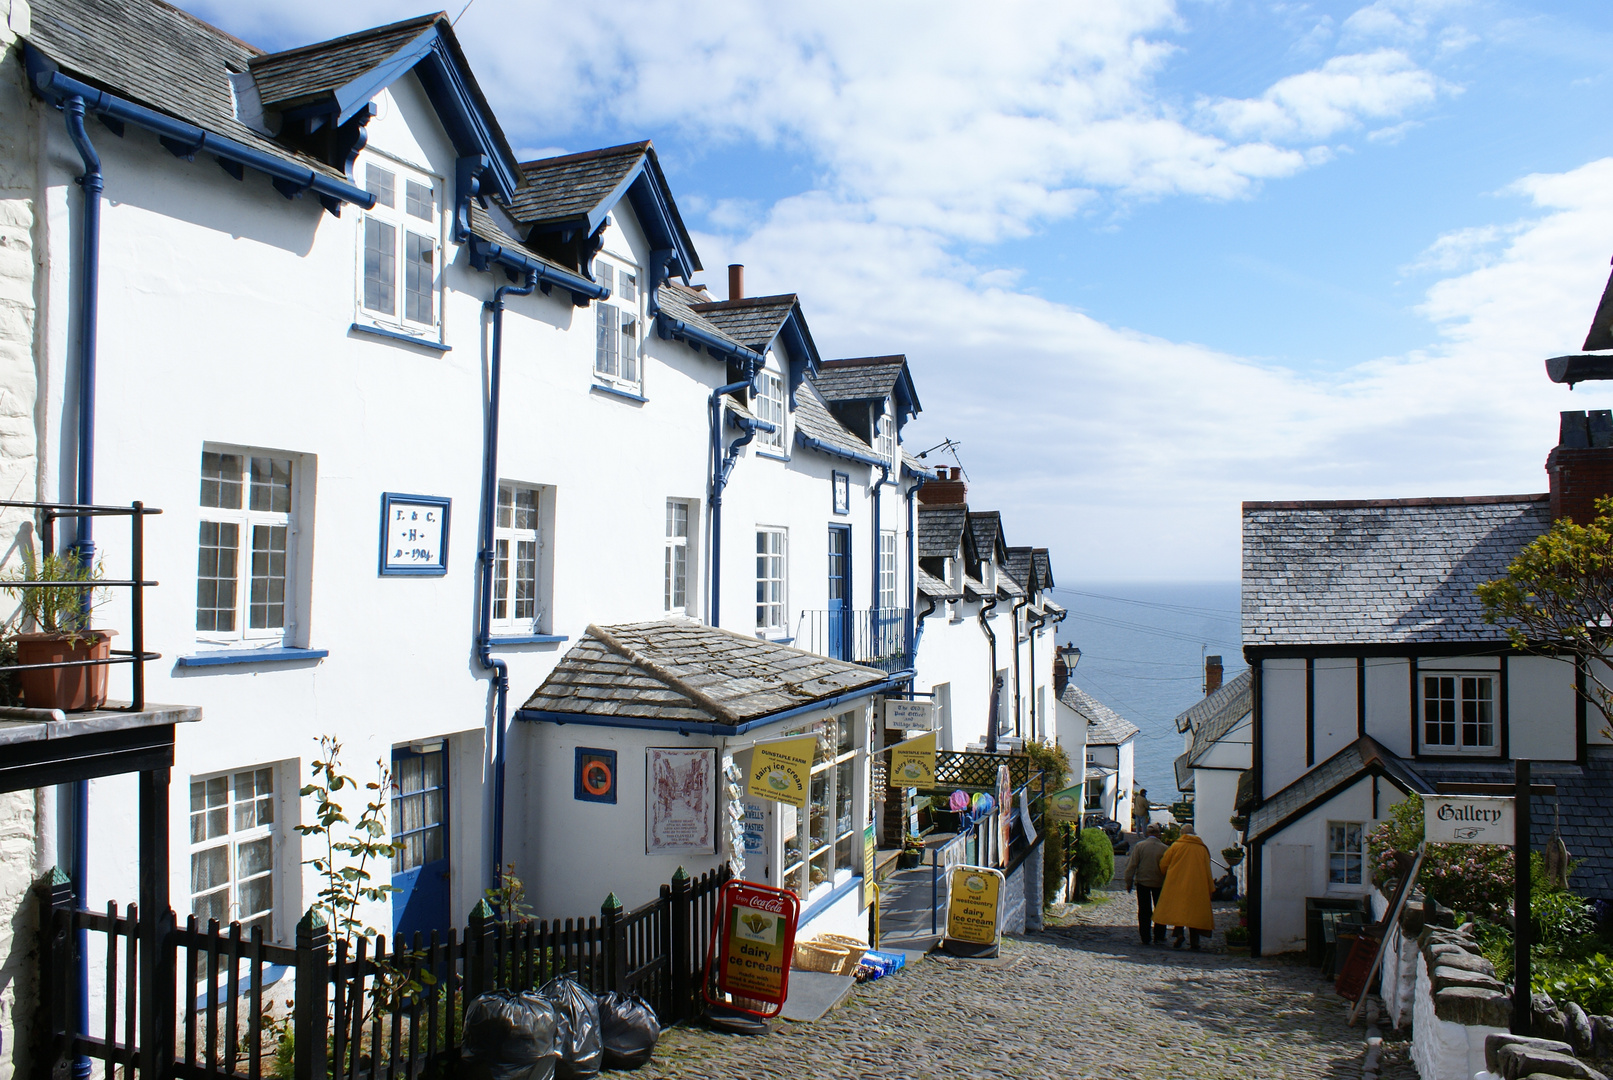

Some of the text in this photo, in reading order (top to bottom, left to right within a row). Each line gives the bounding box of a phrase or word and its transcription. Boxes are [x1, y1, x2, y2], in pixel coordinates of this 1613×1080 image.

[762, 750, 791, 760] DUNSTAPLE
[895, 761, 906, 774] dairy
[917, 760, 931, 776] cream
[755, 762, 802, 790] dairy ice cream
[1437, 803, 1501, 825] Gallery
[745, 823, 764, 831] PASTIES
[736, 895, 748, 903] Enjoy
[956, 898, 993, 907] westcountry
[963, 908, 984, 918] dairy
[967, 917, 994, 926] cream
[740, 944, 771, 961] dairy
[729, 954, 743, 966] ce
